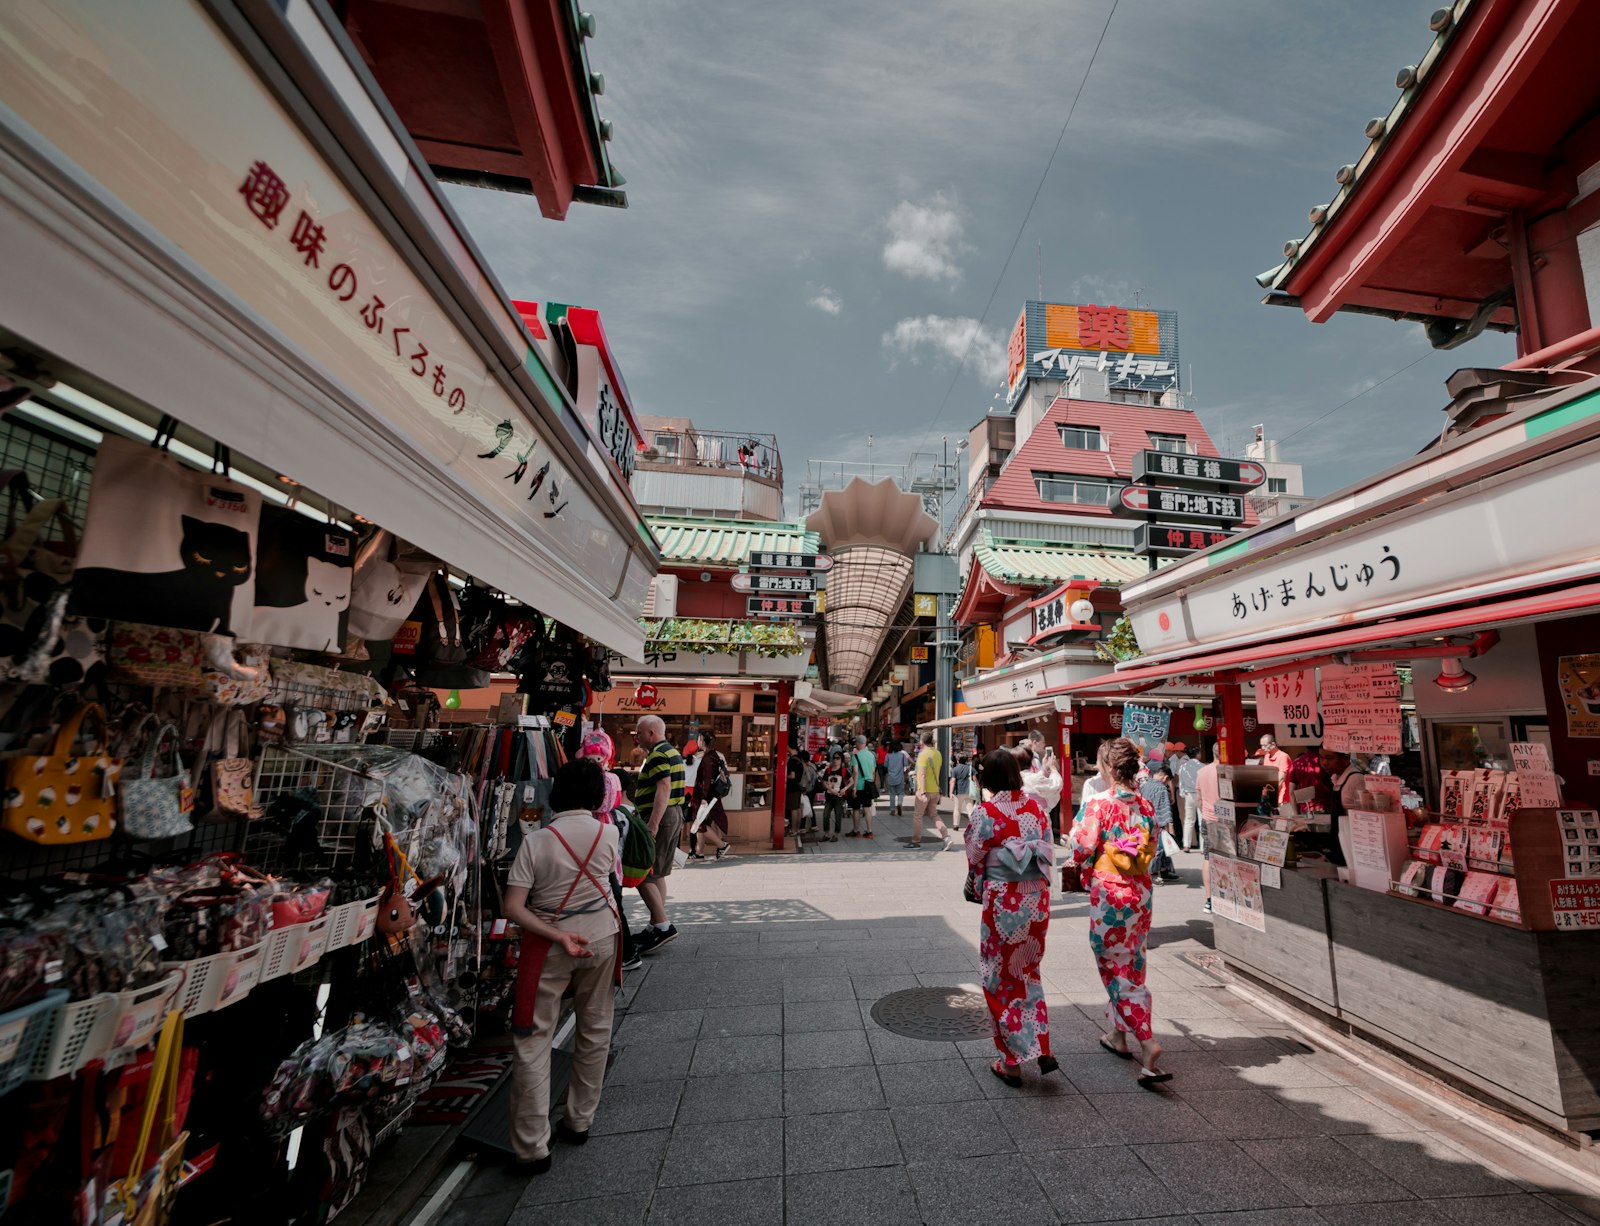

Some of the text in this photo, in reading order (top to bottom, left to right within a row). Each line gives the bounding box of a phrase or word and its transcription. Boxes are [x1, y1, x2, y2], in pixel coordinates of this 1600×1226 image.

[239, 160, 466, 415] 趣味のふくろもの
[1077, 304, 1130, 350] 薬
[1161, 455, 1221, 479] 観音様
[761, 554, 803, 567] 観音様
[1232, 545, 1400, 620] あげまんじゅう
[761, 600, 803, 613] 仲見世
[1265, 681, 1303, 699] ドリンク
[1131, 711, 1161, 726] 電球
[1283, 704, 1310, 719] ¥350
[1126, 723, 1165, 739] ソーダ
[1513, 744, 1534, 756] ANY
[1515, 759, 1531, 770] FOR
